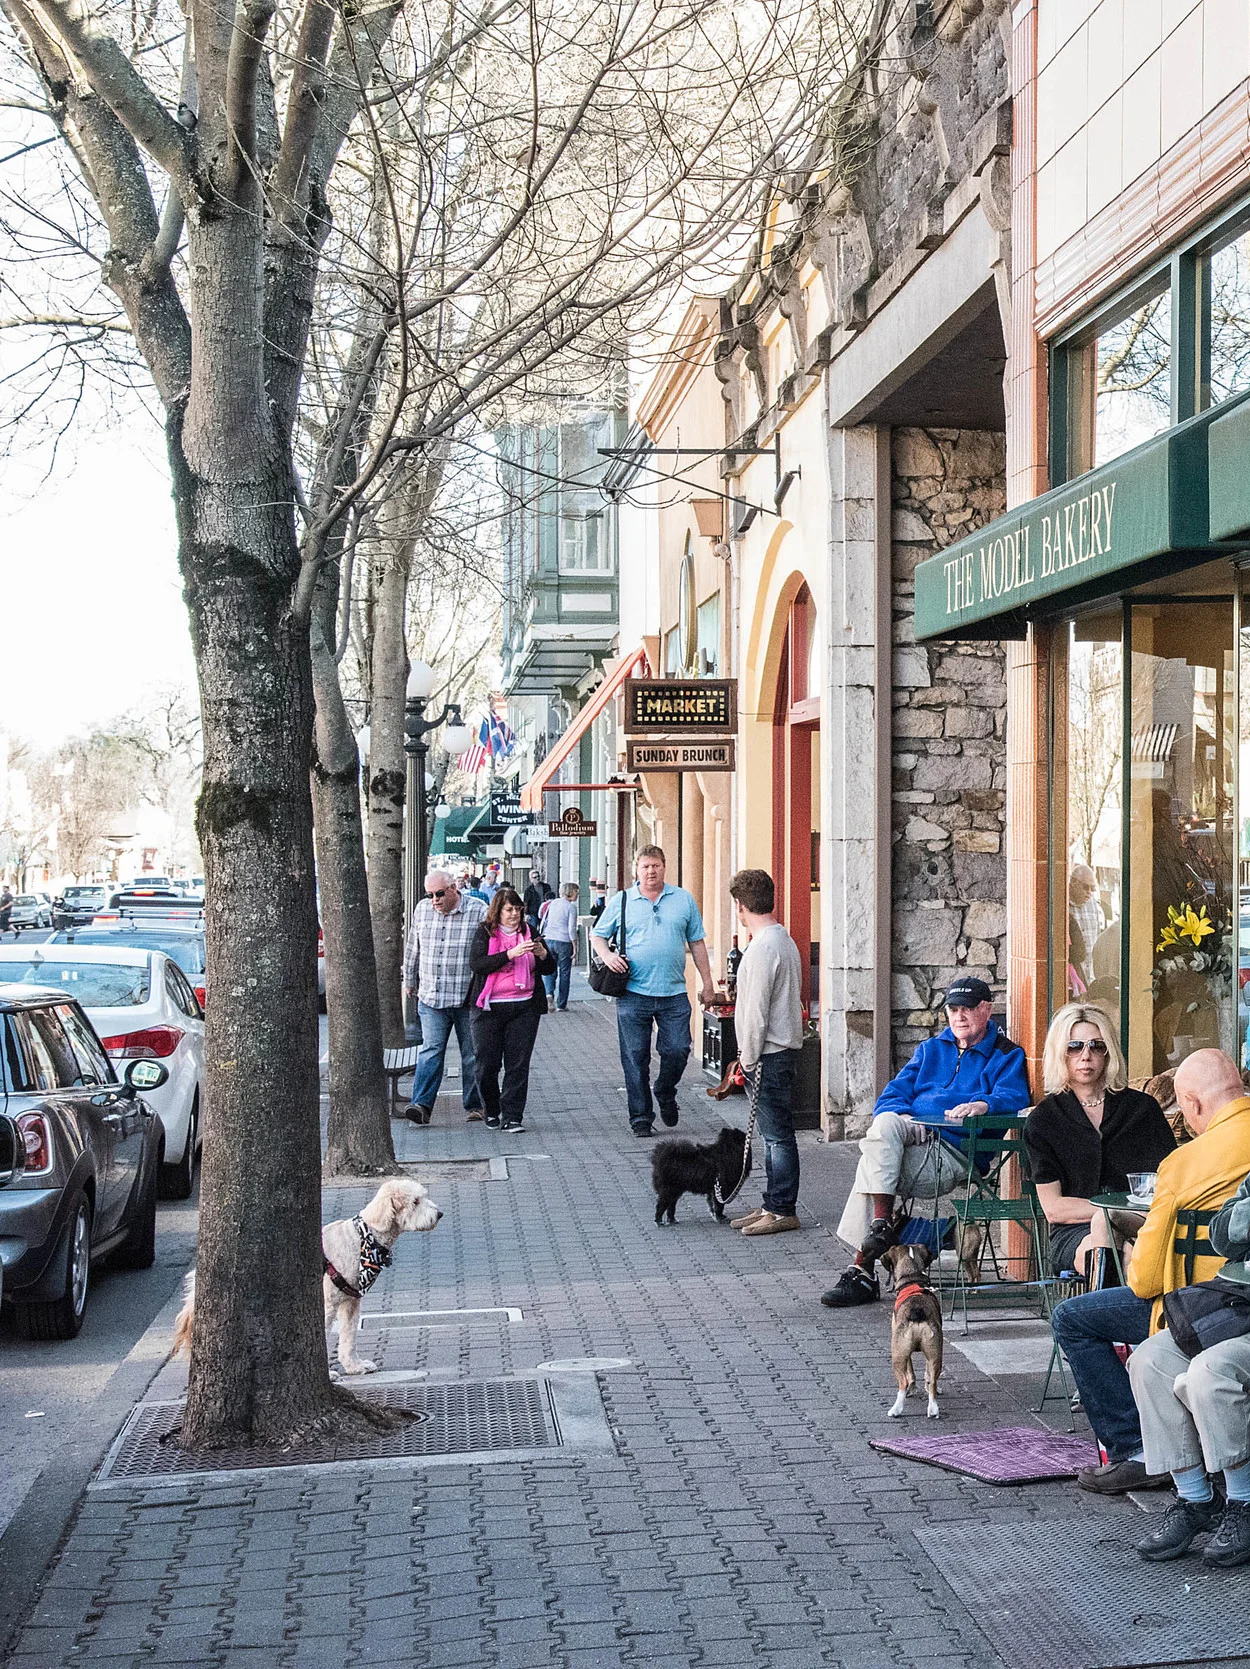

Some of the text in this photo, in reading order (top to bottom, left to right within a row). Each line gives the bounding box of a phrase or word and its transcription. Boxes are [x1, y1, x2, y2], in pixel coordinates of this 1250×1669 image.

[943, 482, 1117, 614] THE MODEL BAKERY
[646, 698, 717, 714] MARKET
[636, 748, 727, 763] SUNDAY BRUNCH
[497, 804, 530, 814] WIN
[497, 815, 528, 824] CENTER
[552, 822, 595, 832] Palladium
